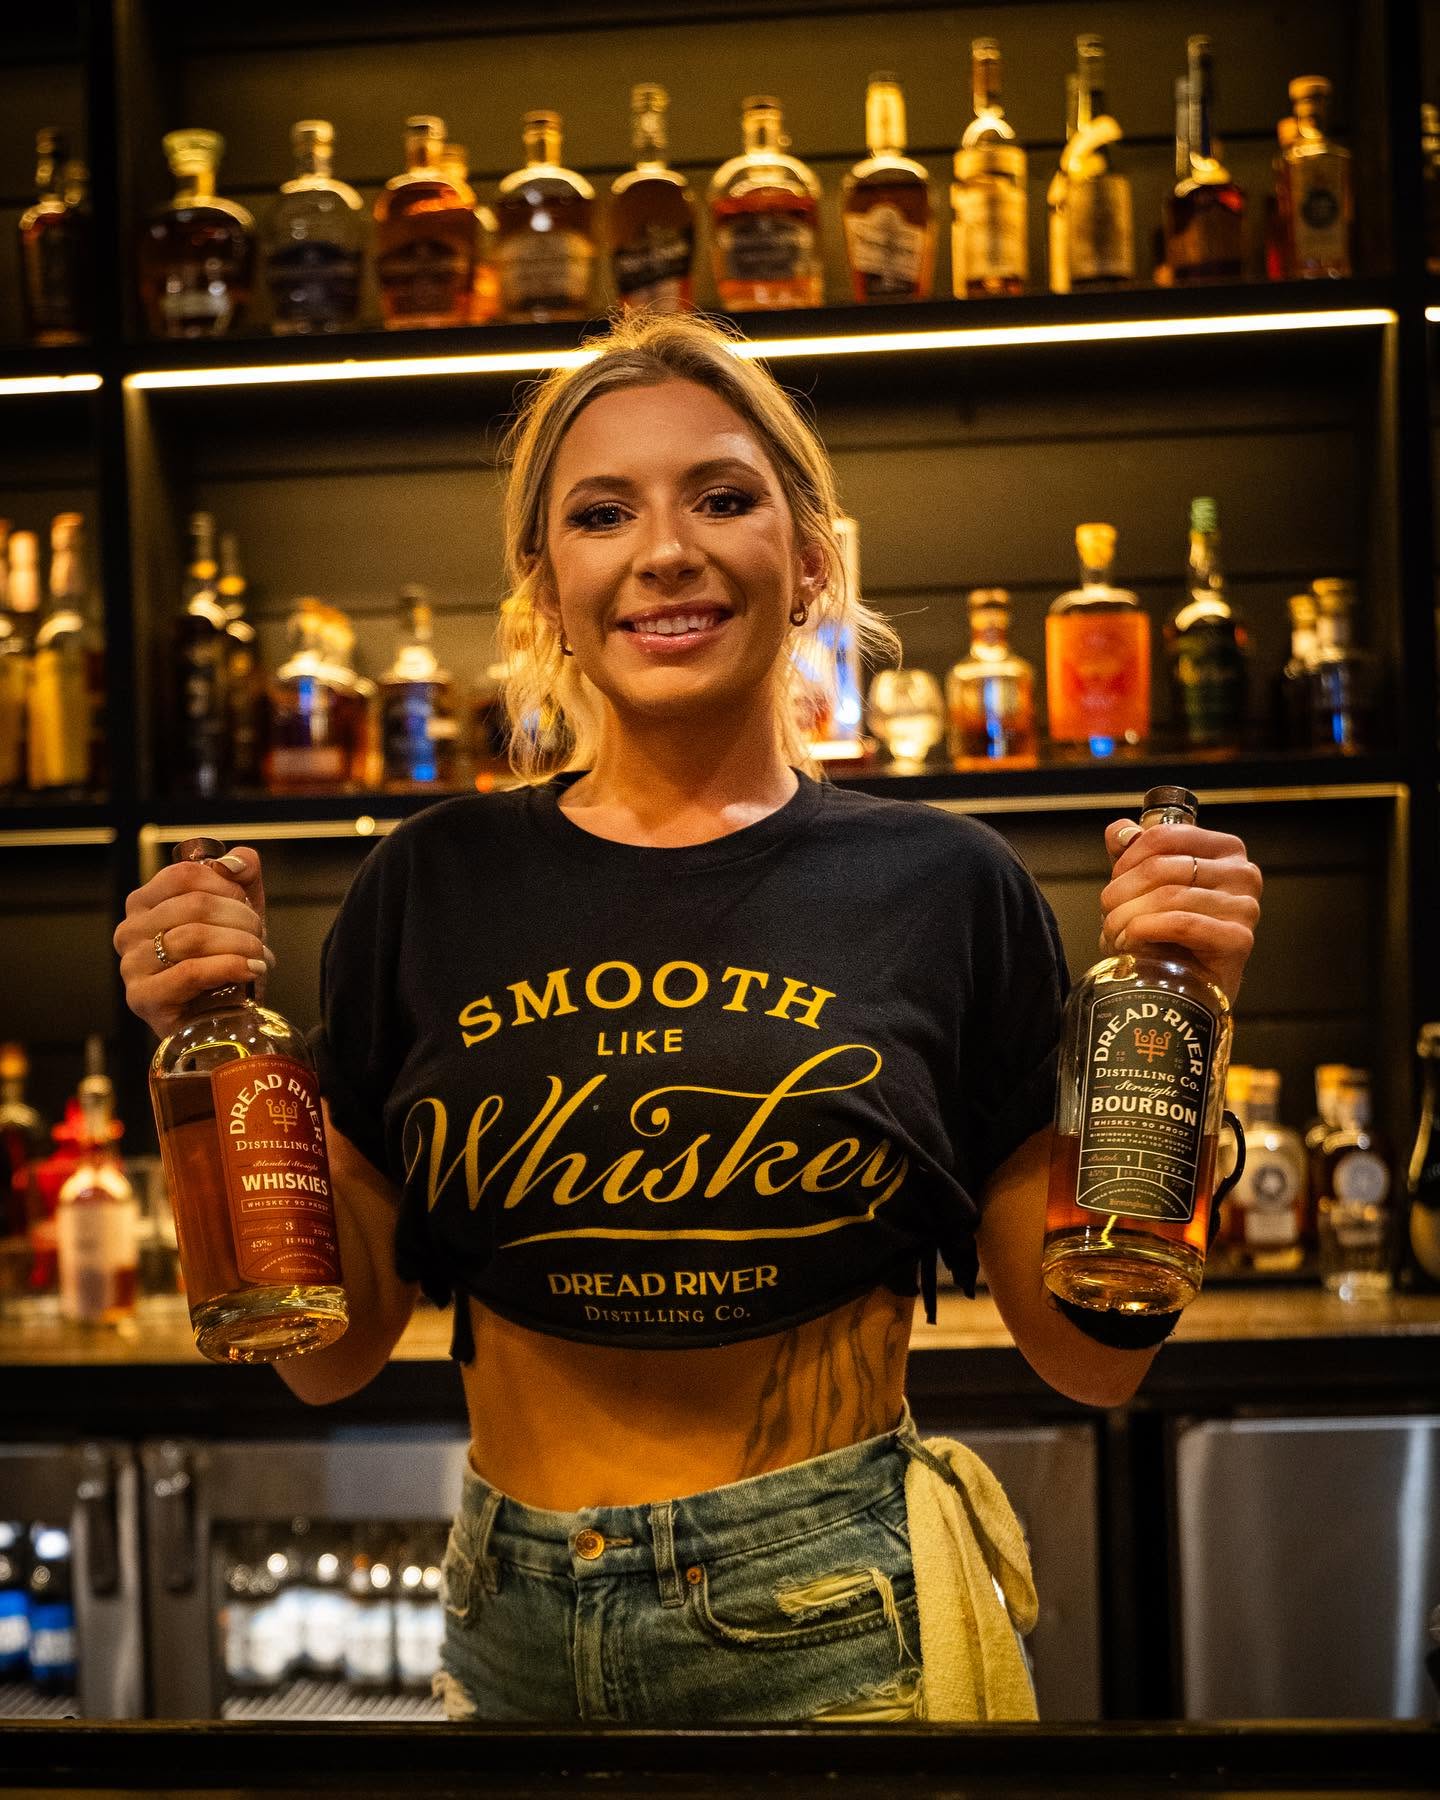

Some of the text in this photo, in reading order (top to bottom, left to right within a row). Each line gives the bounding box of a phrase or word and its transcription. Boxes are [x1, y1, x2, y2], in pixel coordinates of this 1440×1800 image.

[459, 960, 837, 1049] SMOOTH
[597, 1029, 684, 1056] LIKE
[1093, 1003, 1159, 1062] DREAD
[1163, 1008, 1203, 1077] RIVER
[1095, 1067, 1176, 1083] DISTILLING
[1115, 1079, 1180, 1099] Straight
[229, 1074, 323, 1143] DREAD RIVER
[1091, 1095, 1197, 1126] BOURBON
[1141, 1121, 1156, 1129] 90
[1159, 1124, 1189, 1137] PROOF
[235, 1140, 309, 1153] DISTILLING
[402, 1044, 912, 1247] Whiskey
[1126, 1153, 1131, 1162] 1
[241, 1172, 328, 1196] WHISKIES
[246, 1199, 290, 1209] WHISKEY
[294, 1199, 306, 1207] 90
[284, 1220, 295, 1232] 3
[548, 1264, 779, 1298] DREAD RIVER
[585, 1305, 705, 1324] DISTILLING
